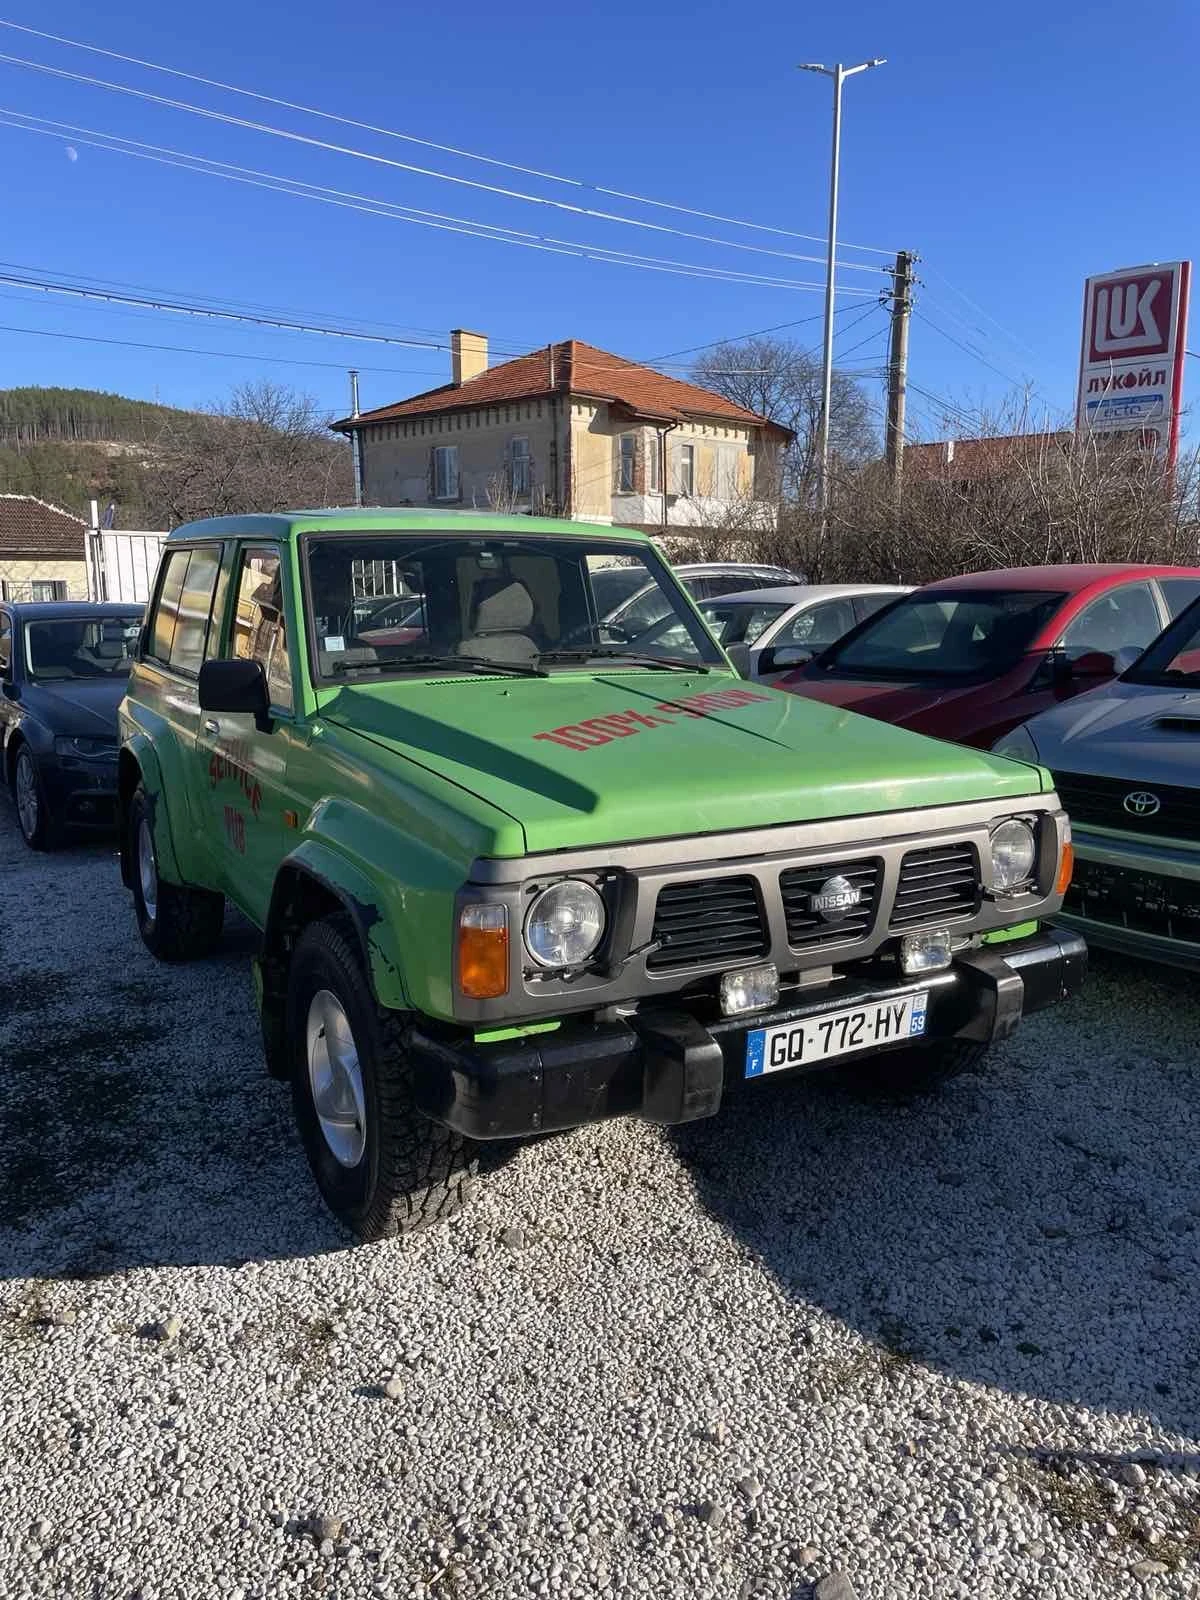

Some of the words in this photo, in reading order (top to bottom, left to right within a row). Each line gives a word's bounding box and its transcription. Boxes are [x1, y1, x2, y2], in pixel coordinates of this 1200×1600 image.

[1087, 367, 1166, 393] ЛУКОЙЛ
[532, 709, 676, 752] 100%
[813, 891, 860, 912] NISSAN
[911, 1015, 925, 1032] 59
[751, 1059, 759, 1070] F
